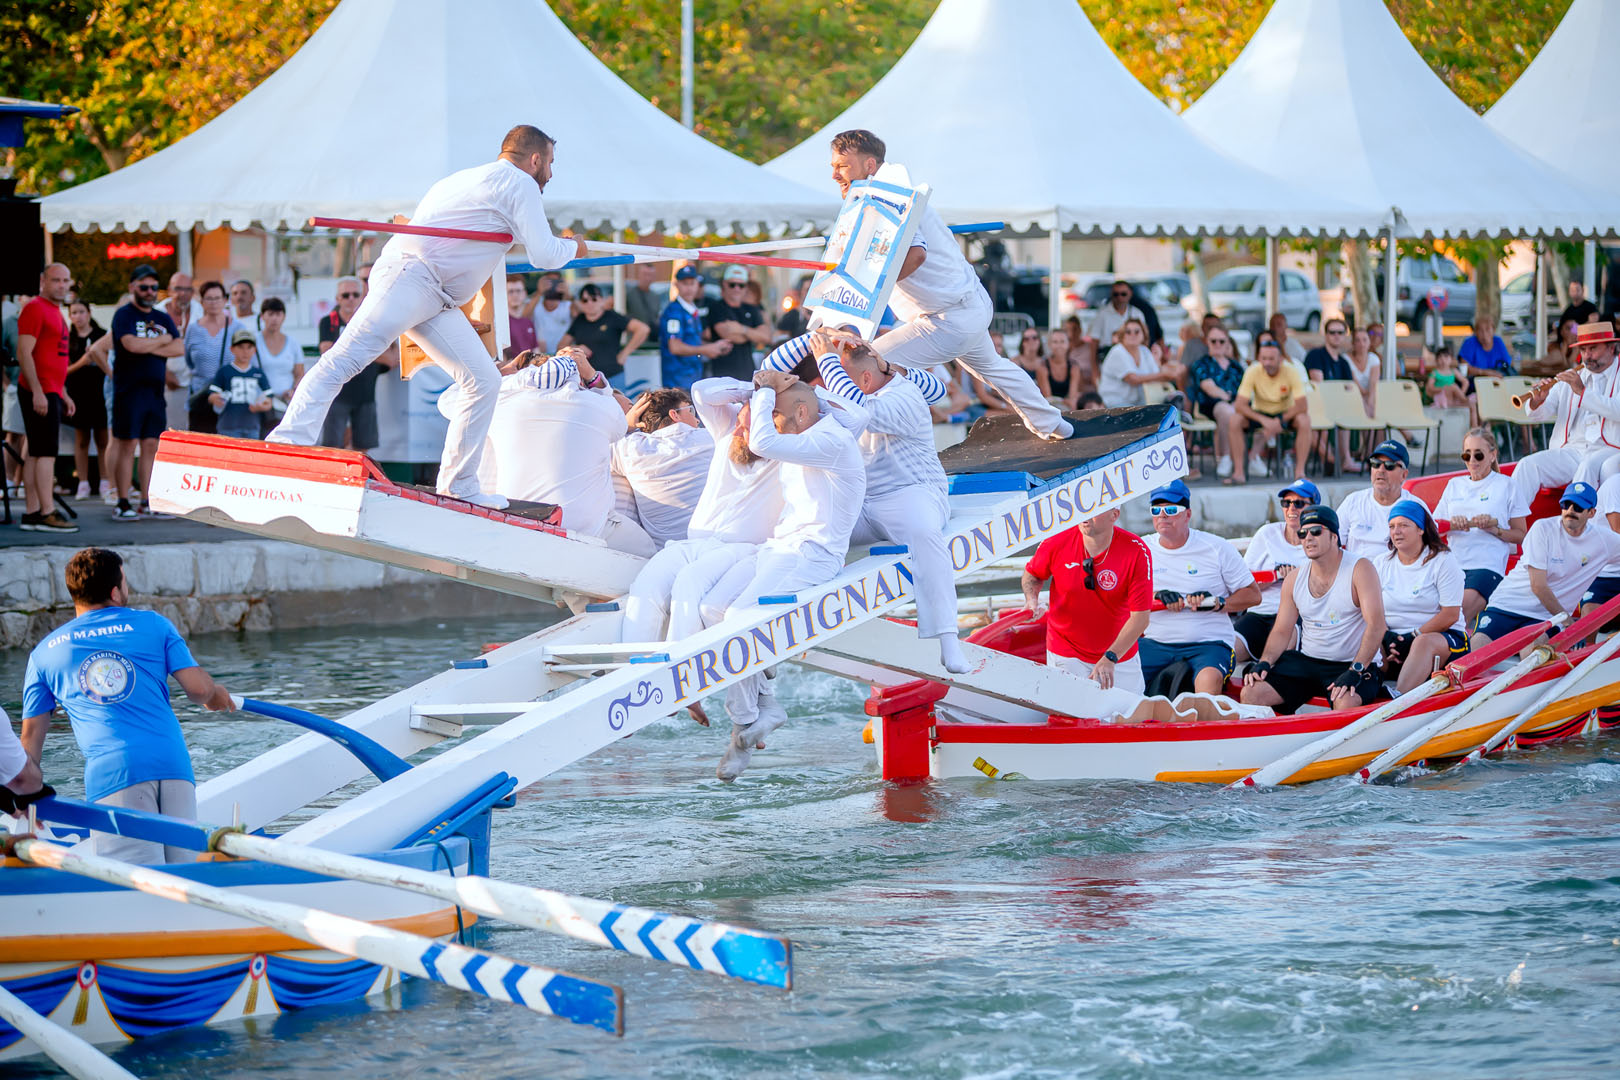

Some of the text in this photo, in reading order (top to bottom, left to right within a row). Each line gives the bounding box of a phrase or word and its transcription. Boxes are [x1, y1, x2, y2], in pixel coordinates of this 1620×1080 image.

[180, 472, 304, 503] SJF FRONTIGNAN
[668, 561, 914, 704] FRONTIGNAN
[1001, 459, 1134, 549] MUSCAT
[47, 623, 134, 648] GIN MARINA
